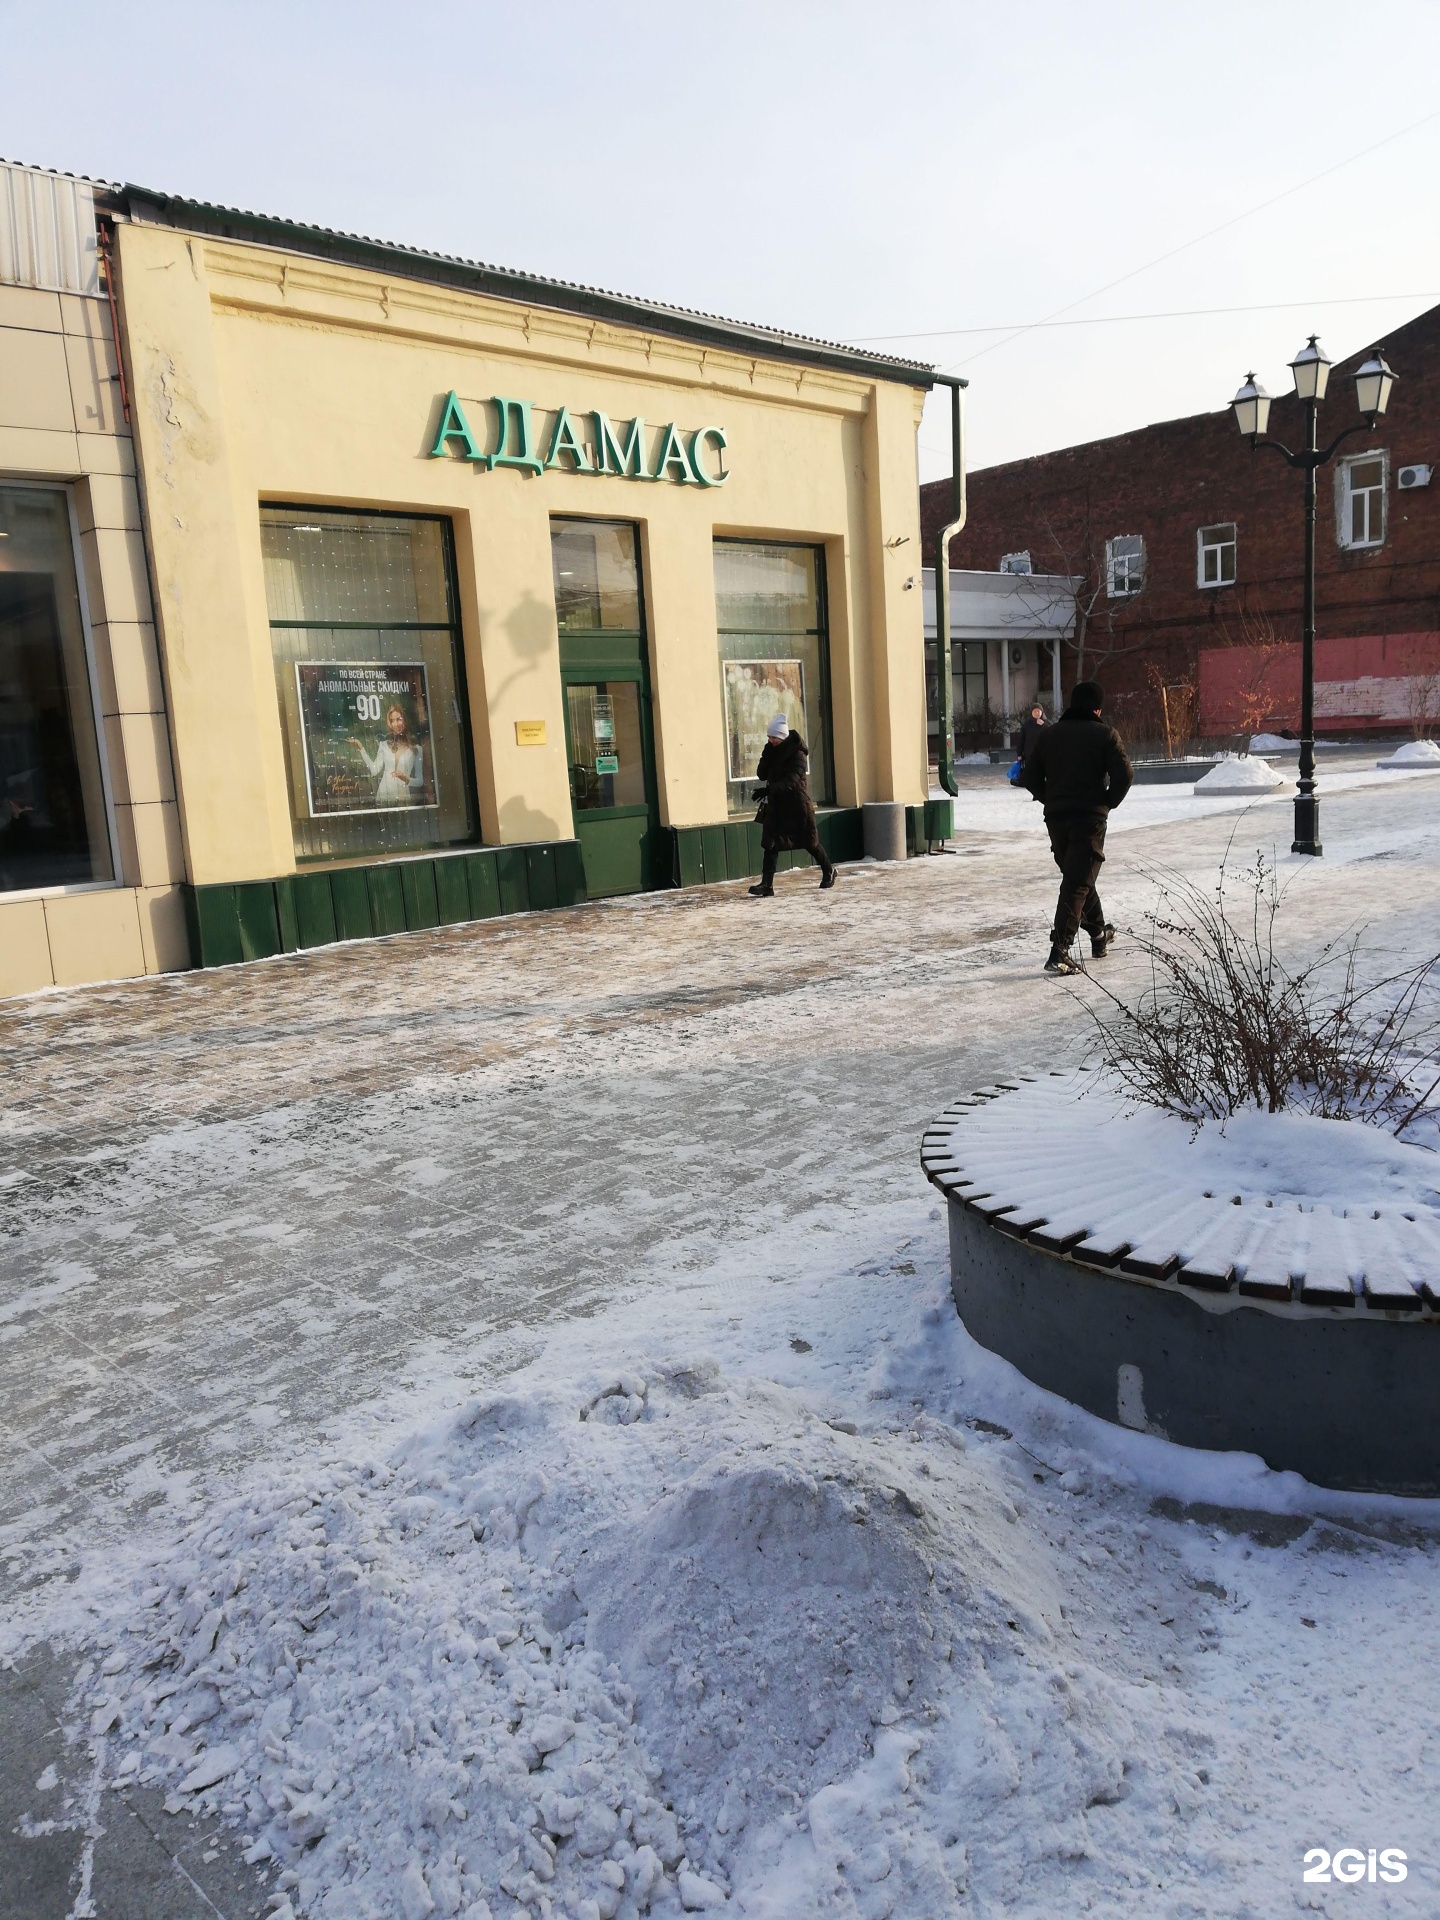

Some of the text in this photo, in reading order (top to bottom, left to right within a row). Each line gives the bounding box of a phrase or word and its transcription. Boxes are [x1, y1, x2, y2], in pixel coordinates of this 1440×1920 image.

[431, 389, 731, 487] АДАМАС
[339, 669, 387, 680] ПО ВСЕЙ СТРАНЕ
[318, 680, 410, 694] АНОМАЛЬНЫЕ СКИДКИ
